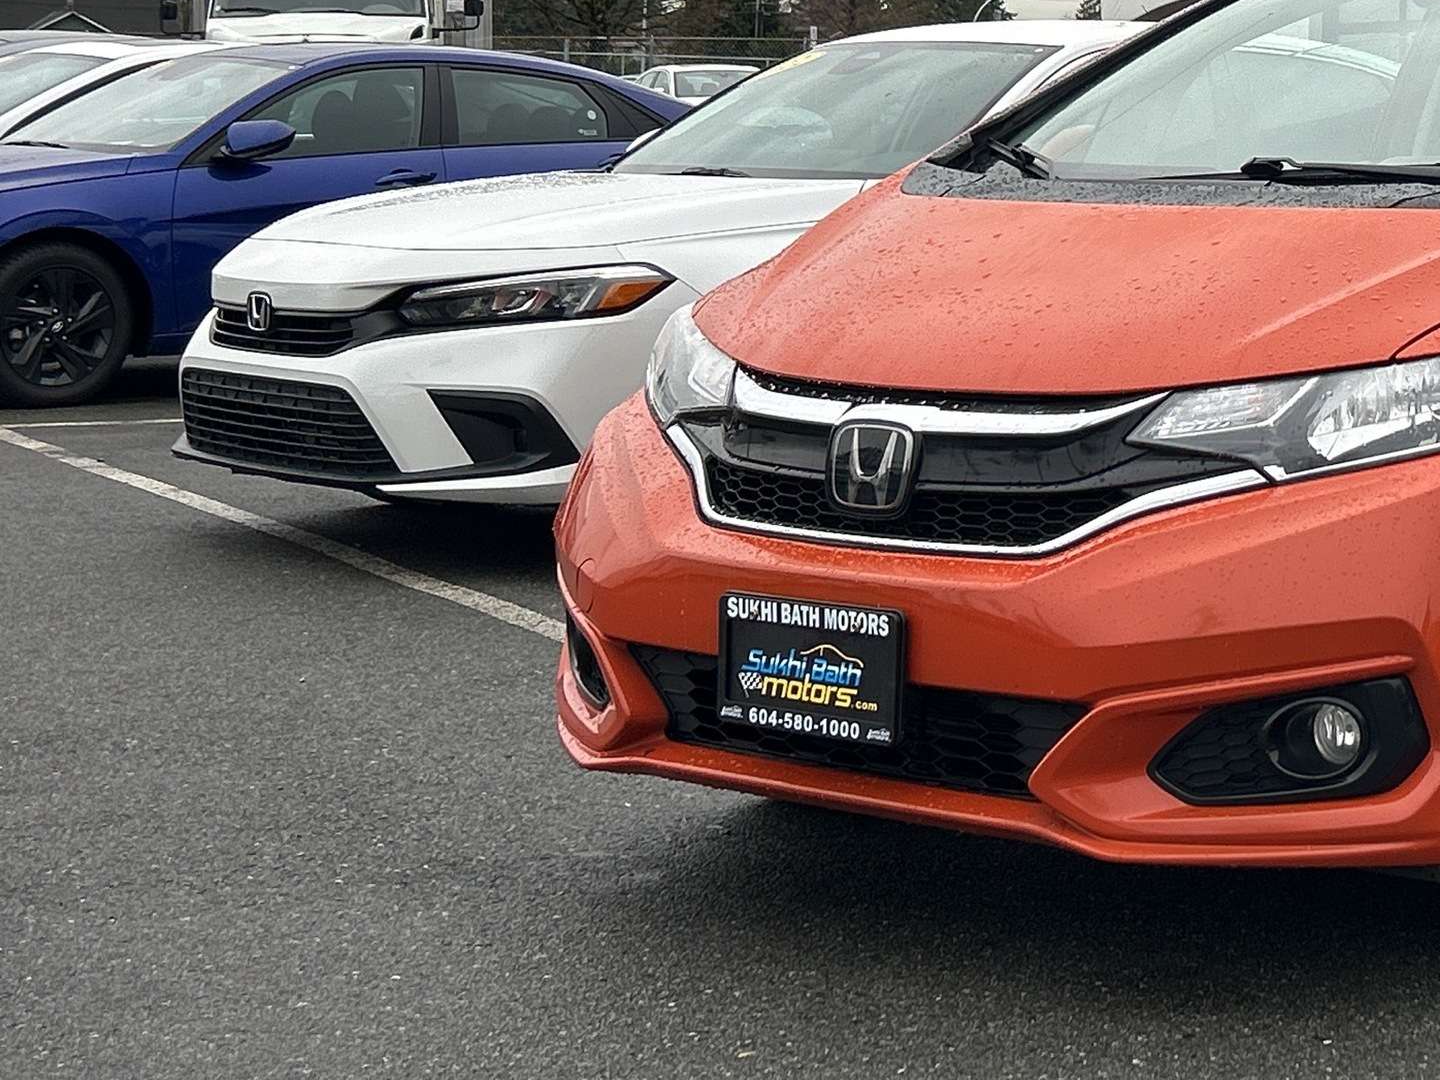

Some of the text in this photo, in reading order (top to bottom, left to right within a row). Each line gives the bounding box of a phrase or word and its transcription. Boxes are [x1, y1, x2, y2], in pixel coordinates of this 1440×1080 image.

[727, 596, 890, 638] SUKHI BATH MOTORS
[741, 648, 862, 687] Sukhi Bath
[748, 706, 861, 740] 604-580-1000
